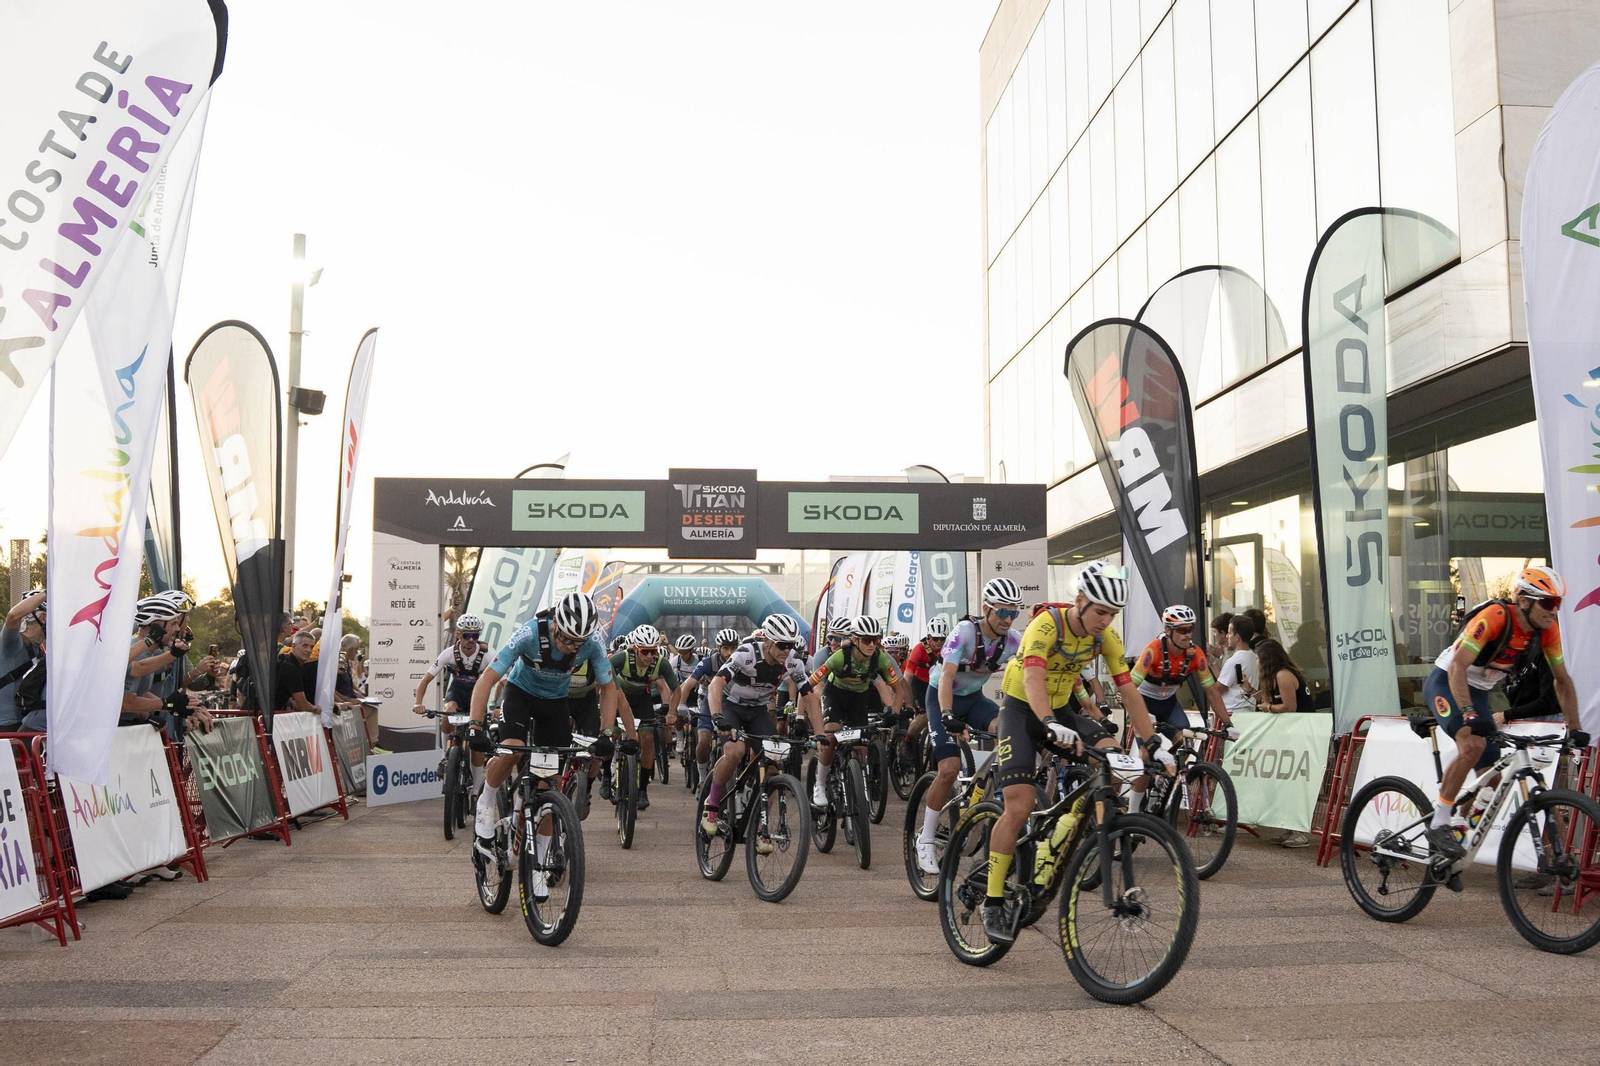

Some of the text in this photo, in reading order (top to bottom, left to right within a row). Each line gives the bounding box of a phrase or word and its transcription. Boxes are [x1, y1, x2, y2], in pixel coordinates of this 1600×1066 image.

[76, 41, 133, 104] DE
[21, 75, 193, 332] ALMERÍA
[425, 489, 496, 507] Andalucía
[682, 514, 745, 525] DESERT
[933, 523, 980, 531] DIPUTACIÓN
[993, 523, 1026, 531] ALMERÍA
[690, 529, 735, 538] ALMERÍA
[663, 586, 747, 598] UNIVERSAE
[694, 598, 724, 606] Superior
